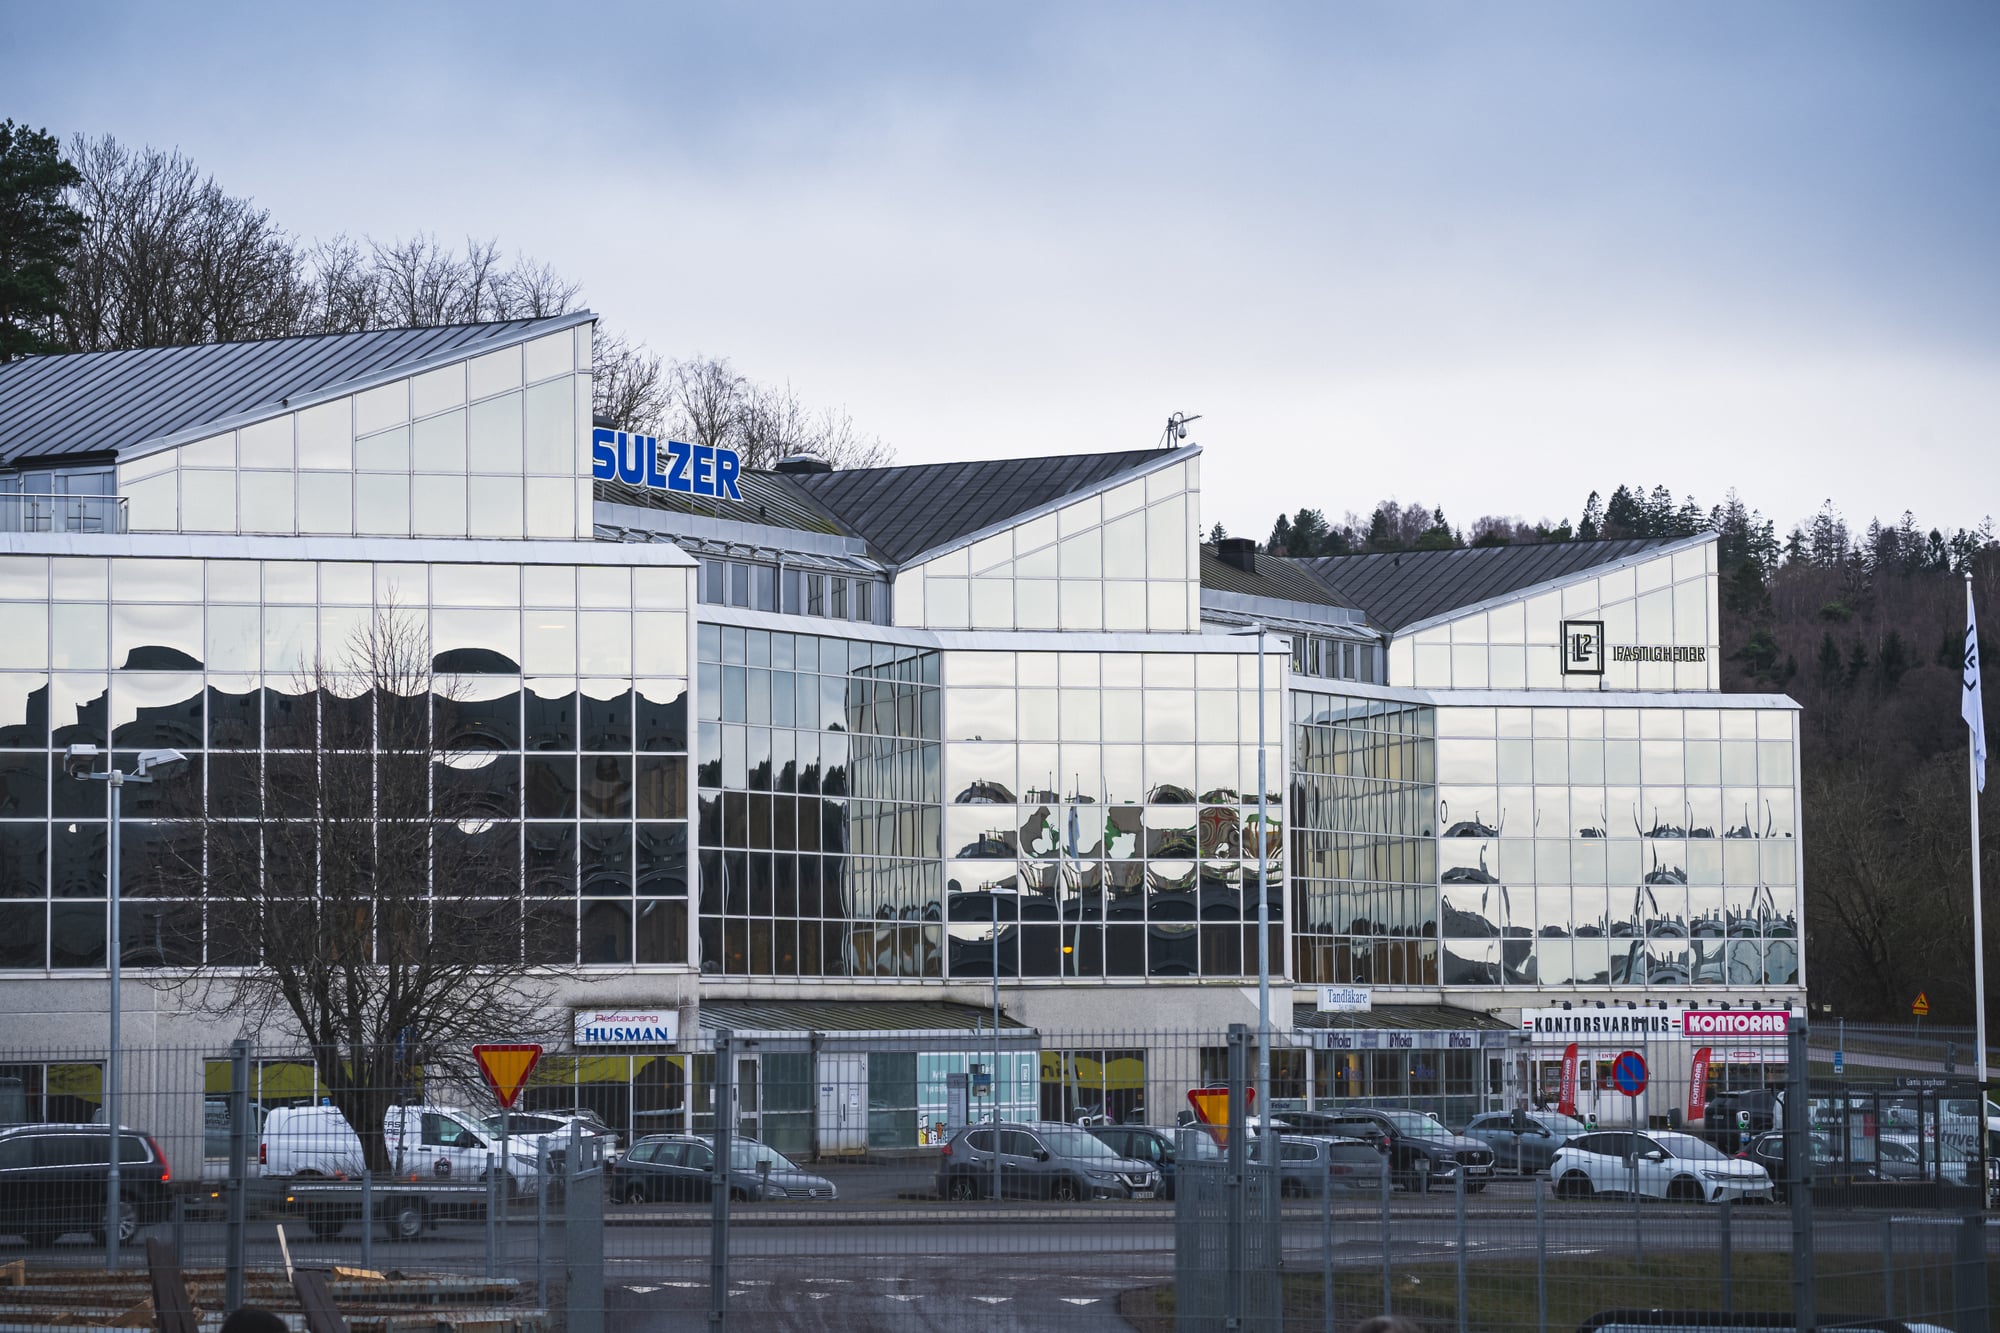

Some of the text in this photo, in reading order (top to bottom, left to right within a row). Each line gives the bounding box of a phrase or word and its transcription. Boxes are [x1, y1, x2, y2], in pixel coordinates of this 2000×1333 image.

[593, 427, 743, 501] SULZER
[1613, 646, 1706, 662] FASTIGHETER
[1327, 989, 1367, 1003] Tandläkare
[595, 1015, 658, 1023] Restaurang
[1535, 1017, 1669, 1032] KONTORSVARUHUS
[1689, 1015, 1785, 1032] KONTORAB
[585, 1027, 667, 1041] HUSMAN
[1692, 1063, 1702, 1105] KONTORAB
